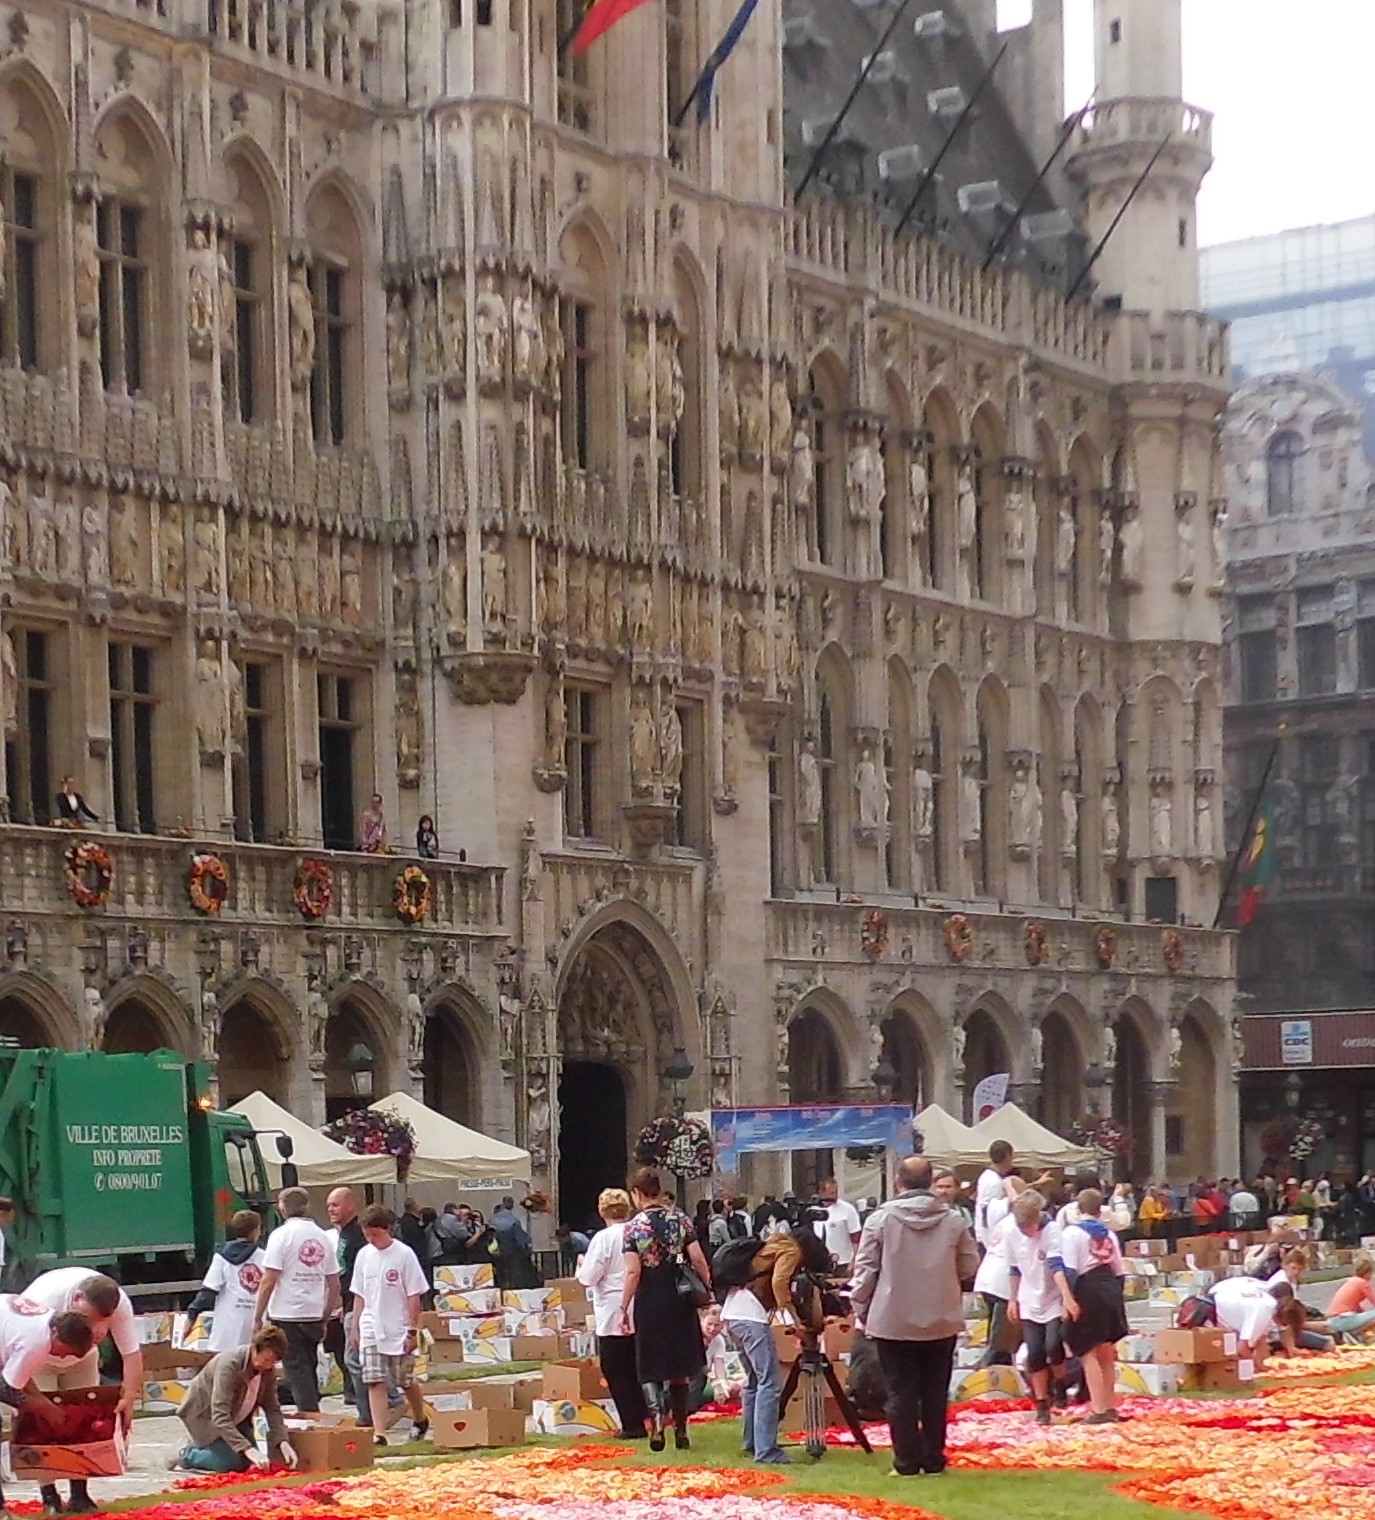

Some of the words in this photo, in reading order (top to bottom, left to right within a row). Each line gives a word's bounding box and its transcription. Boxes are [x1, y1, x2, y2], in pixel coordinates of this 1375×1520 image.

[1284, 1037, 1309, 1046] CBC
[66, 1125, 100, 1144] VILLE
[102, 1125, 119, 1143] DE
[120, 1125, 183, 1143] BRUXELLES
[93, 1149, 115, 1166] INFO
[117, 1149, 162, 1166] PROPRETE
